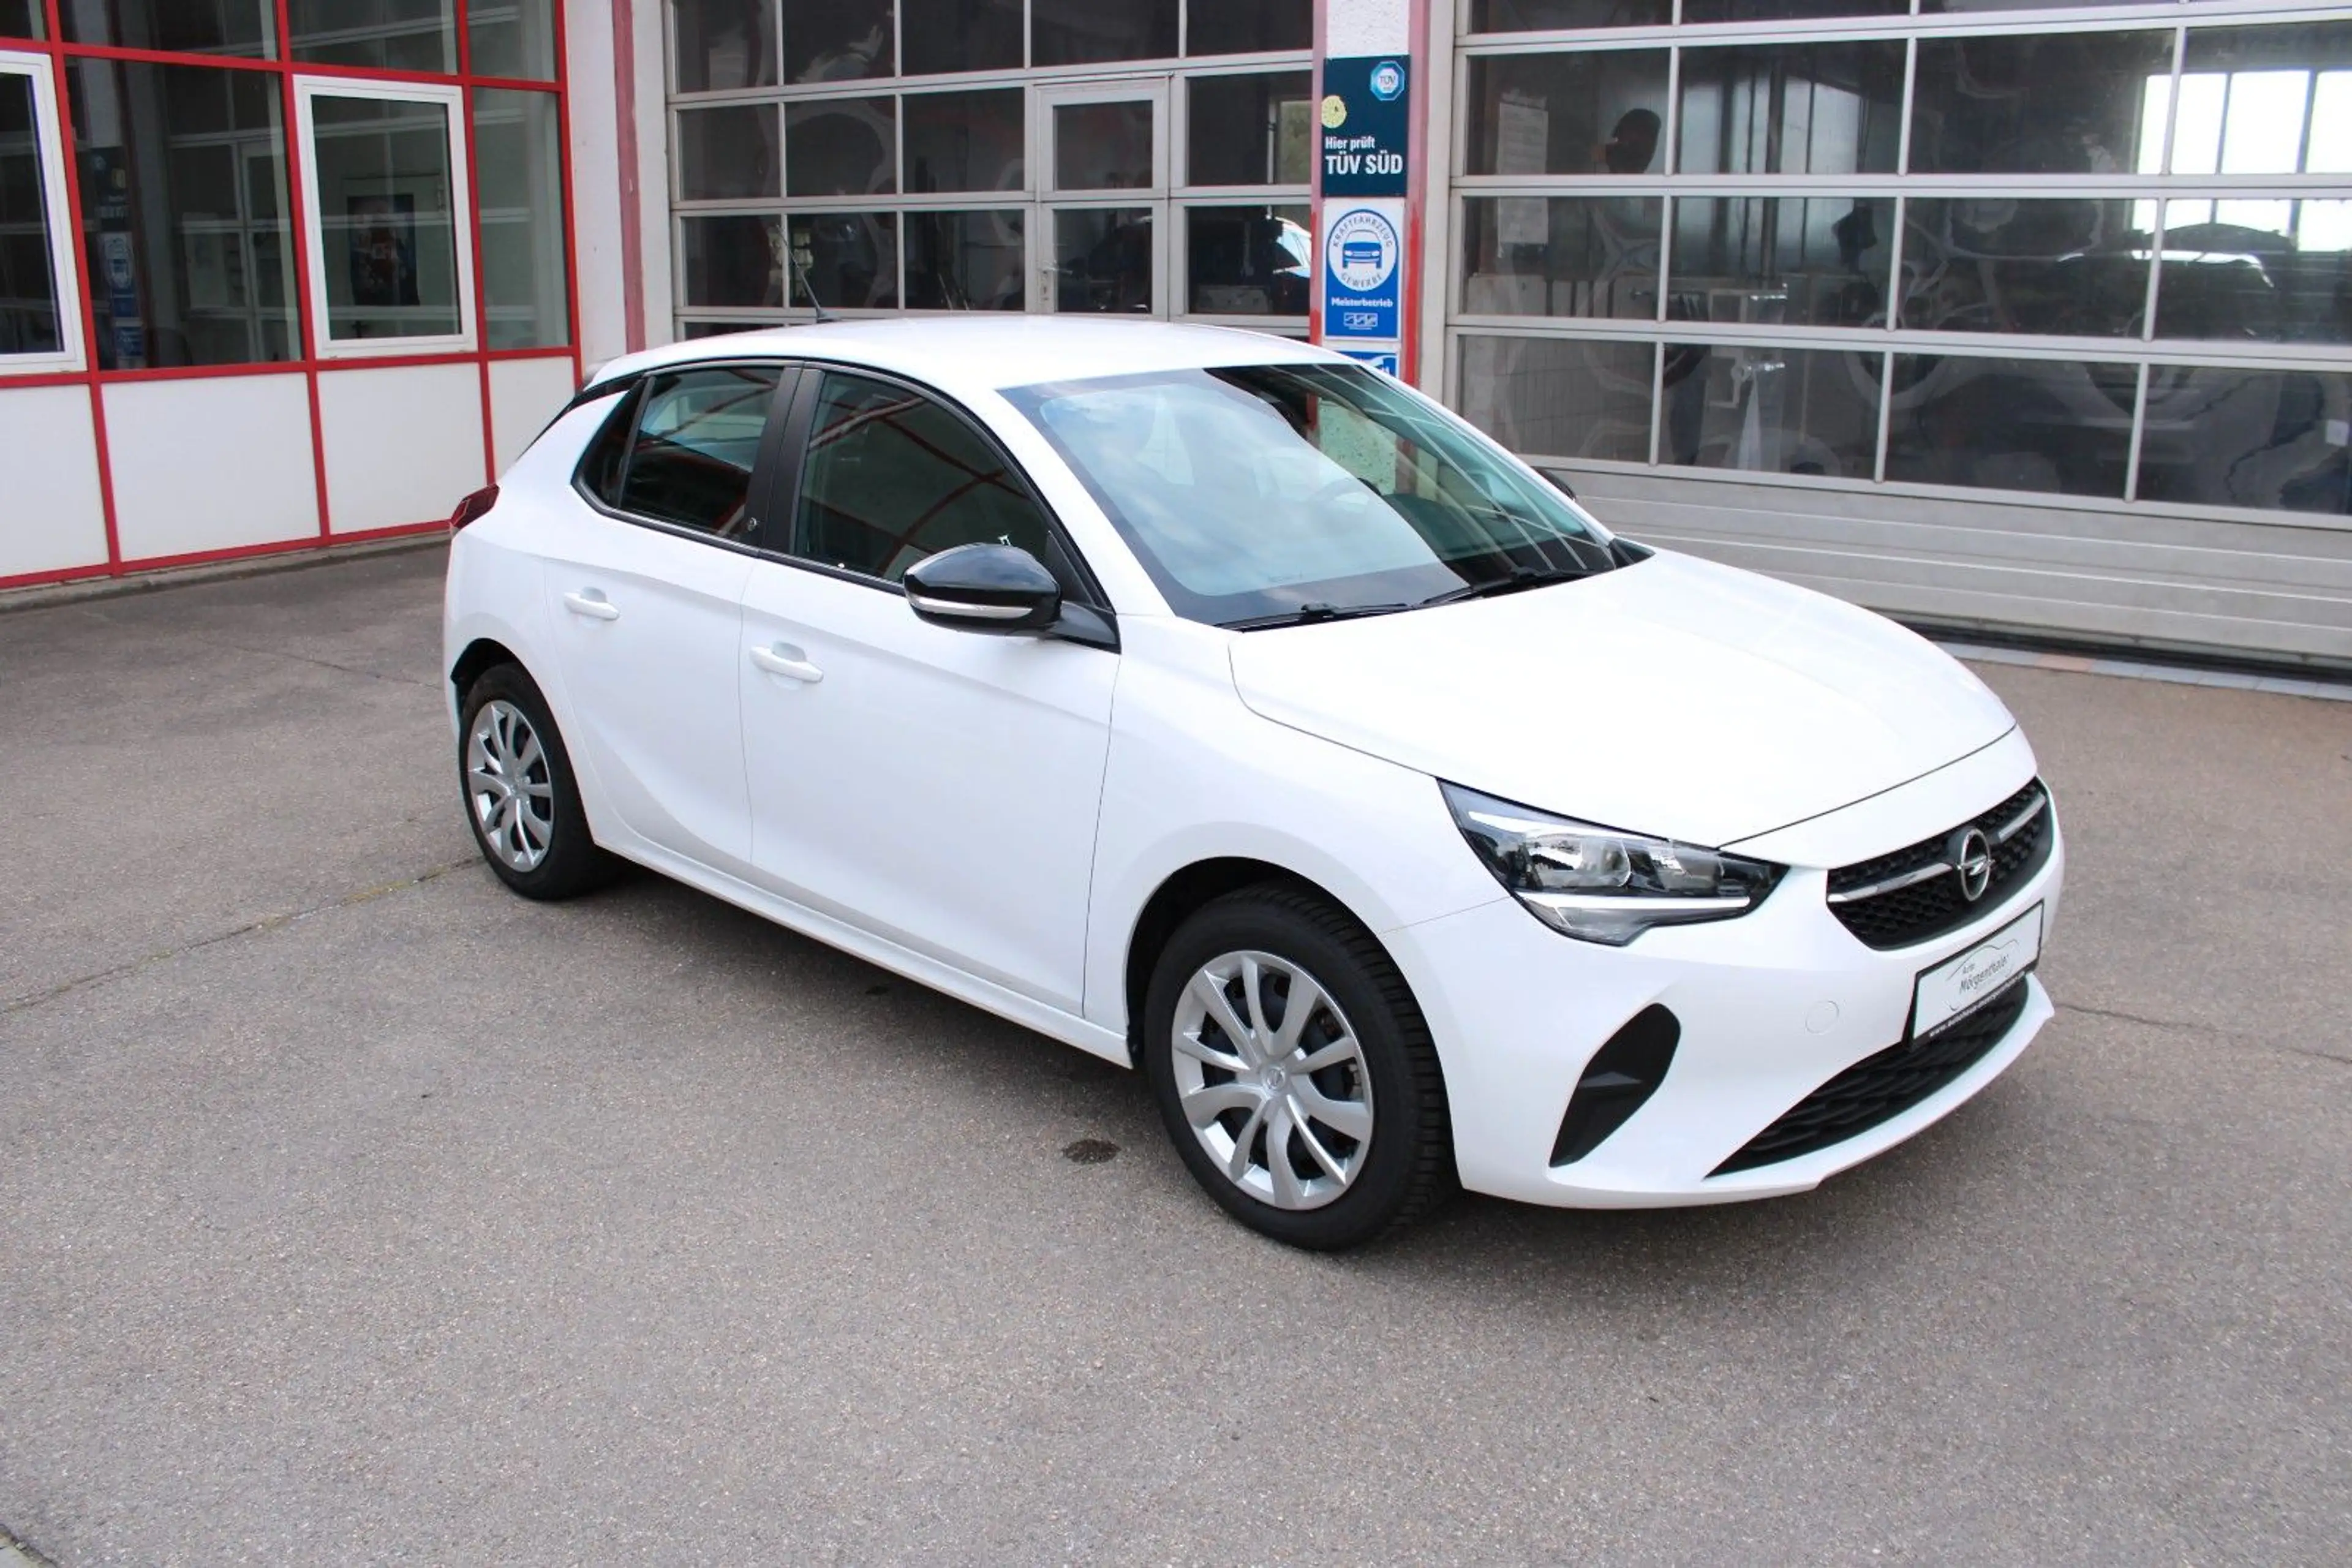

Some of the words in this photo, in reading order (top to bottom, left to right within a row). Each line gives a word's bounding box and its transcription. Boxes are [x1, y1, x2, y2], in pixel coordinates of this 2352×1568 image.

[1325, 136, 1348, 149] Hier
[1349, 135, 1376, 152] prüft
[1325, 151, 1362, 175] TÜV
[1365, 149, 1403, 175] SÜD
[1333, 214, 1393, 247] KRAFTFAHRZEUG
[1341, 272, 1383, 288] GEWERBE
[1331, 296, 1393, 308] Meisterbetrieb
